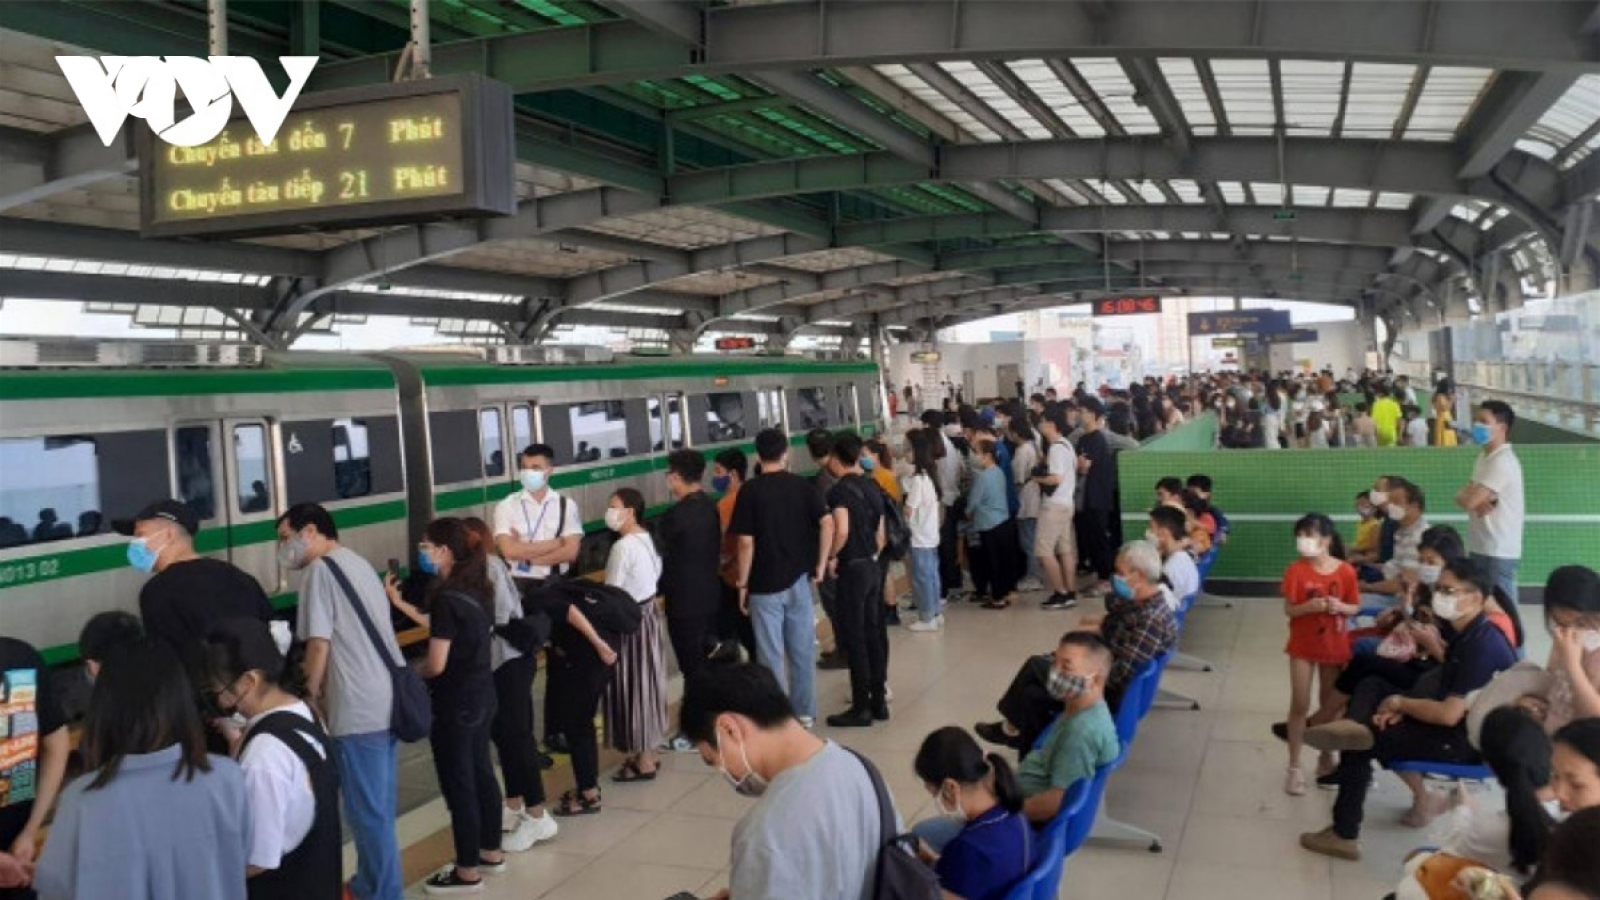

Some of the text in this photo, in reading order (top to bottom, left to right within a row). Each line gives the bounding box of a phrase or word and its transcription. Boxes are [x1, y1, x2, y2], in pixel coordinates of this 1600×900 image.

[289, 121, 327, 150] đến
[338, 122, 355, 151] 7
[387, 116, 443, 144] Phút
[170, 164, 448, 213] Chuyến tàu tiếp 21 Phút
[39, 558, 60, 576] 02
